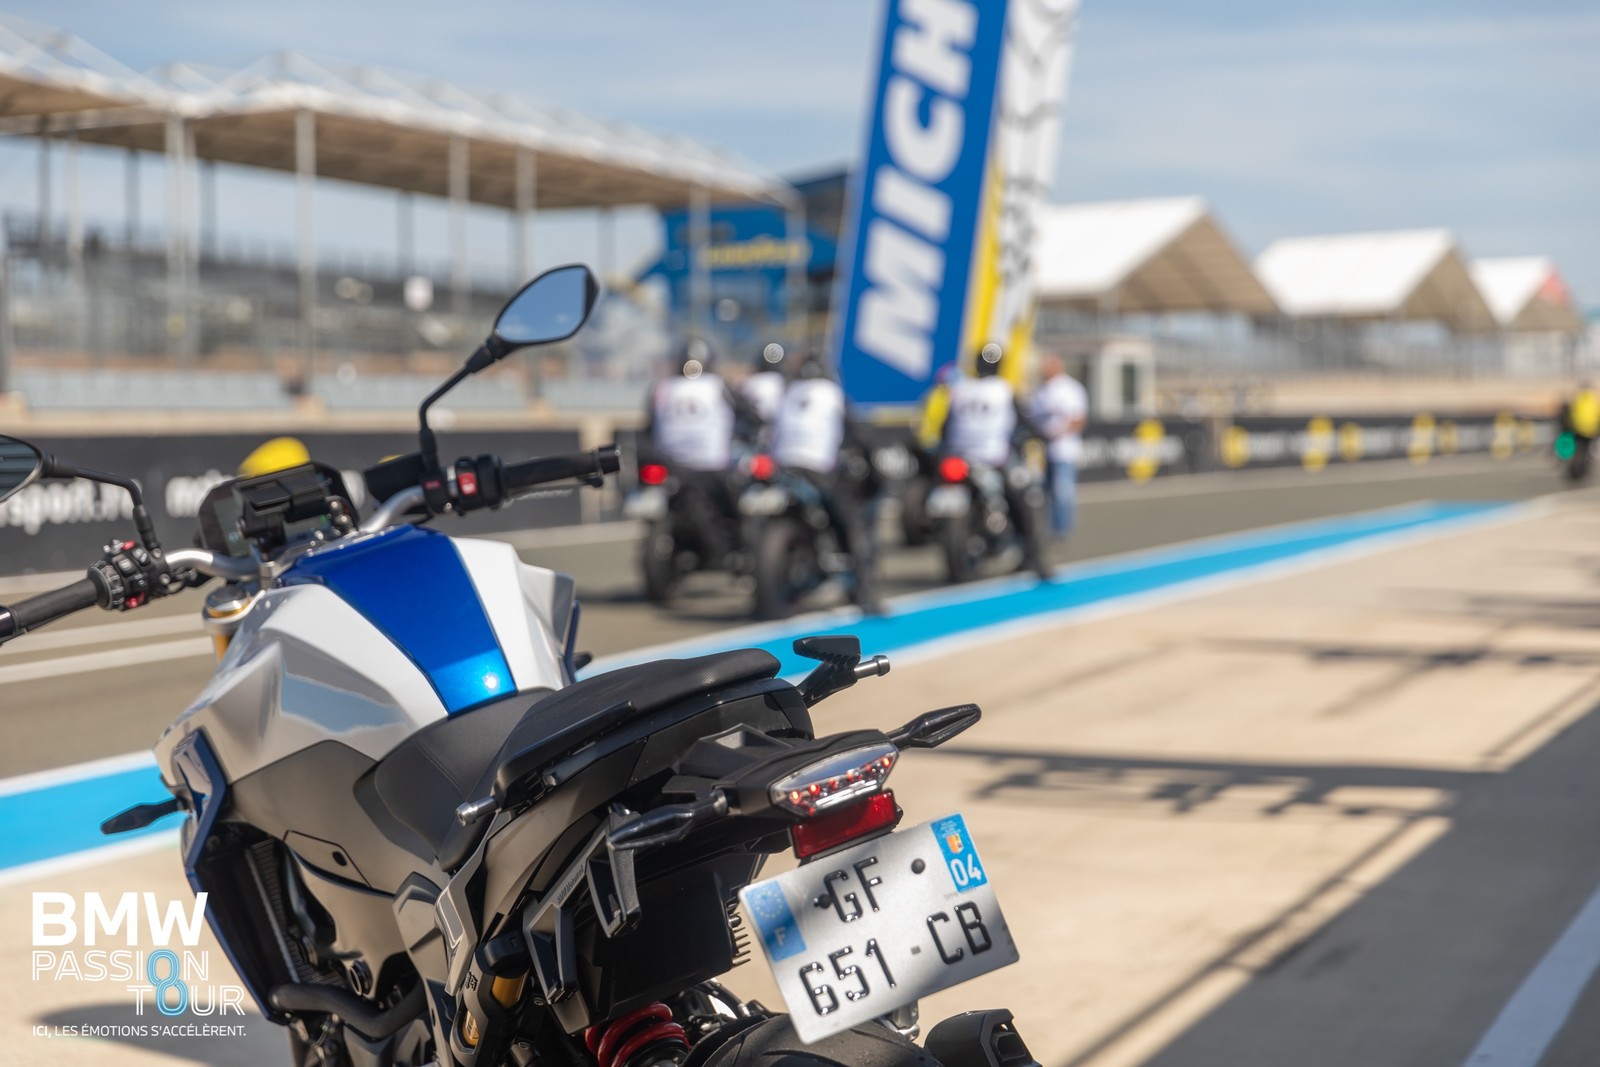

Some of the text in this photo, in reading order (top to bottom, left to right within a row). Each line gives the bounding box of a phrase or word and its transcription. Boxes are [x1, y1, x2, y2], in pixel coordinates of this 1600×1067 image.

[855, 0, 980, 381] MICH
[823, 855, 883, 923] GF
[949, 853, 983, 888] 04
[773, 927, 787, 946] F
[799, 938, 897, 1017] 651
[926, 901, 993, 965] CB
